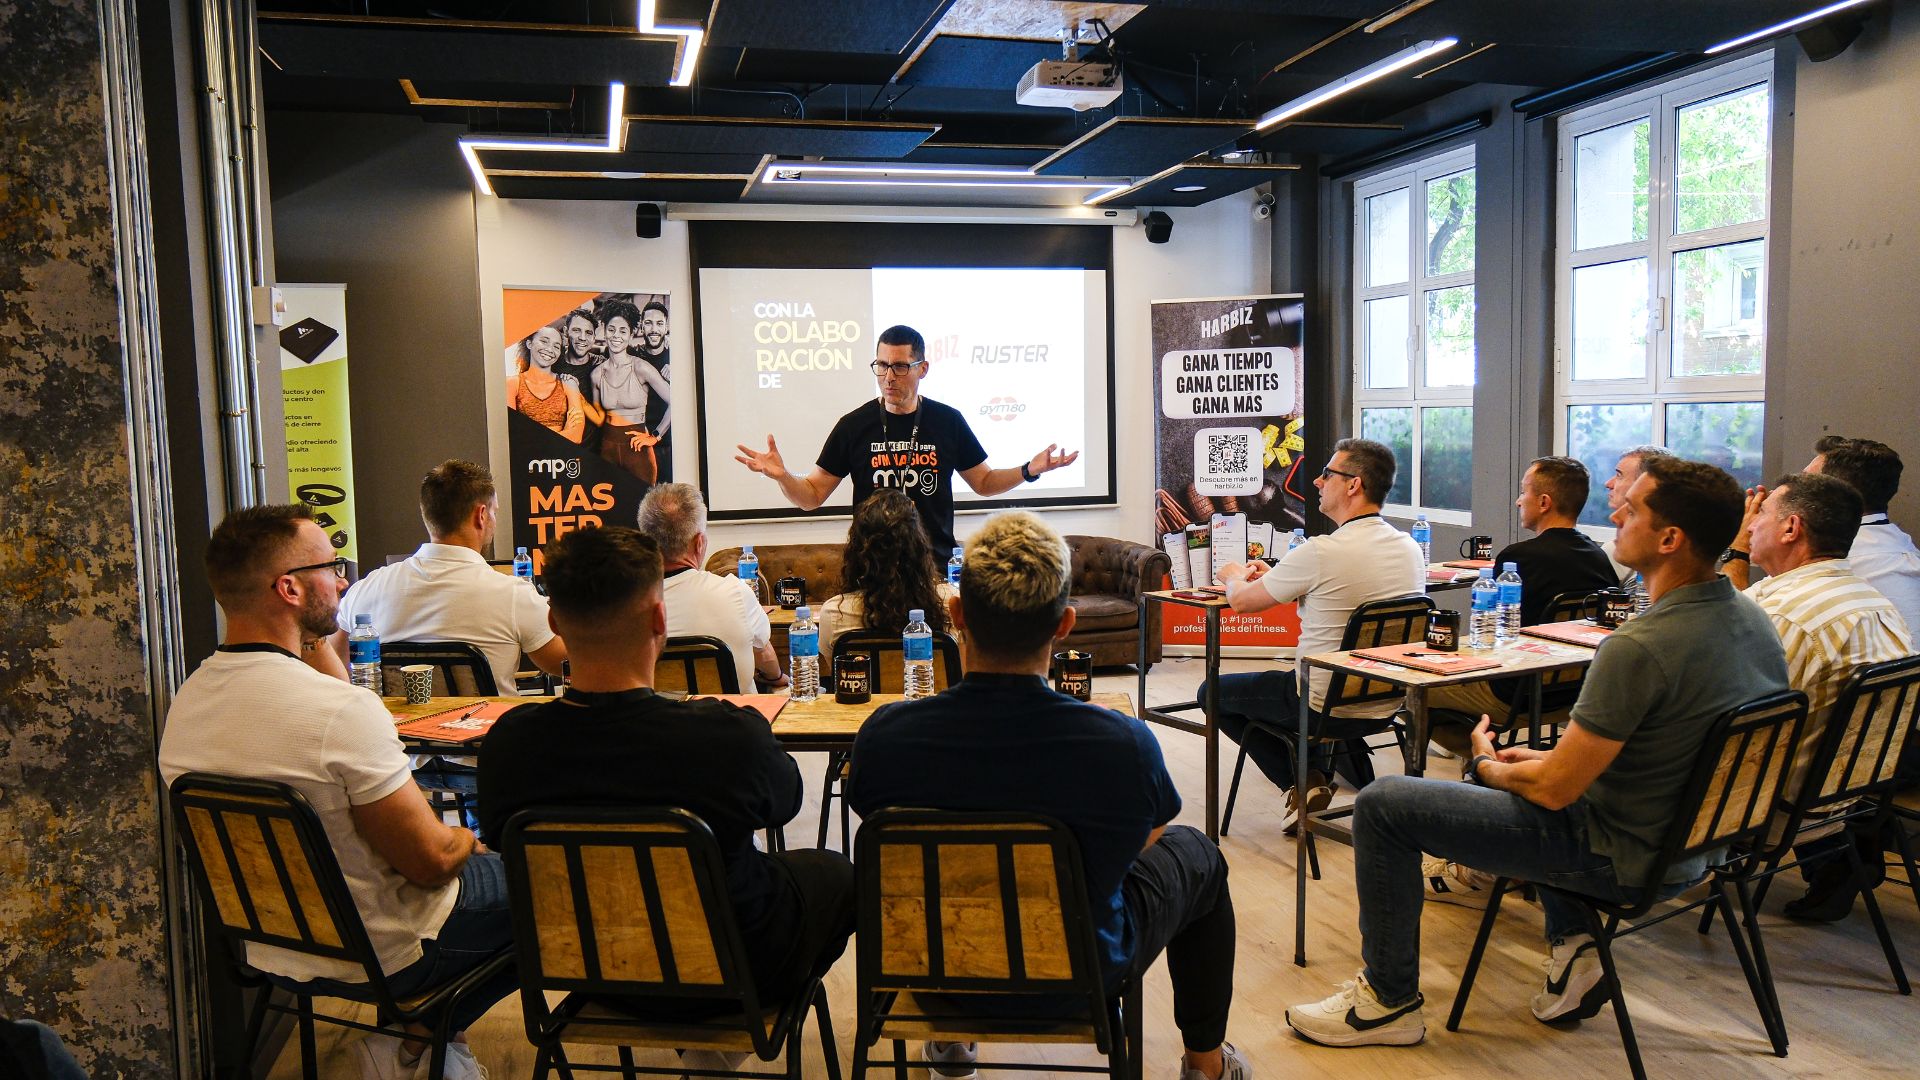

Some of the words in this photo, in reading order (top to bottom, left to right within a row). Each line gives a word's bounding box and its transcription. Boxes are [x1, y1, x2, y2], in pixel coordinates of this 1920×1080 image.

[754, 302, 791, 319] CON
[794, 302, 816, 318] LA
[754, 320, 861, 344] COLABO
[1201, 306, 1254, 339] HARBIZ
[756, 342, 853, 372] RACIÓN
[926, 334, 960, 367] RBIZ
[970, 344, 1049, 364] RUSTER
[1182, 353, 1219, 372] GANA
[1223, 351, 1273, 371] TIEMPO
[758, 373, 782, 389] DE
[1176, 375, 1213, 394] GANA
[1216, 372, 1279, 392] CLIENTES
[979, 403, 1026, 416] gym80
[1192, 396, 1230, 414] GANA
[1233, 391, 1263, 414] MÁS
[310, 465, 342, 473] longevos
[529, 458, 581, 480] mpg
[1233, 475, 1248, 483] más
[872, 468, 939, 496] mpg
[529, 482, 615, 514] MAS
[1173, 624, 1236, 634] profesiales
[1237, 624, 1252, 633] del
[1253, 624, 1288, 633] fitness.
[1197, 615, 1207, 624] La
[1229, 615, 1240, 624] #1
[1241, 617, 1263, 625] para
[840, 679, 868, 693] mpg
[1061, 681, 1089, 694] mpg
